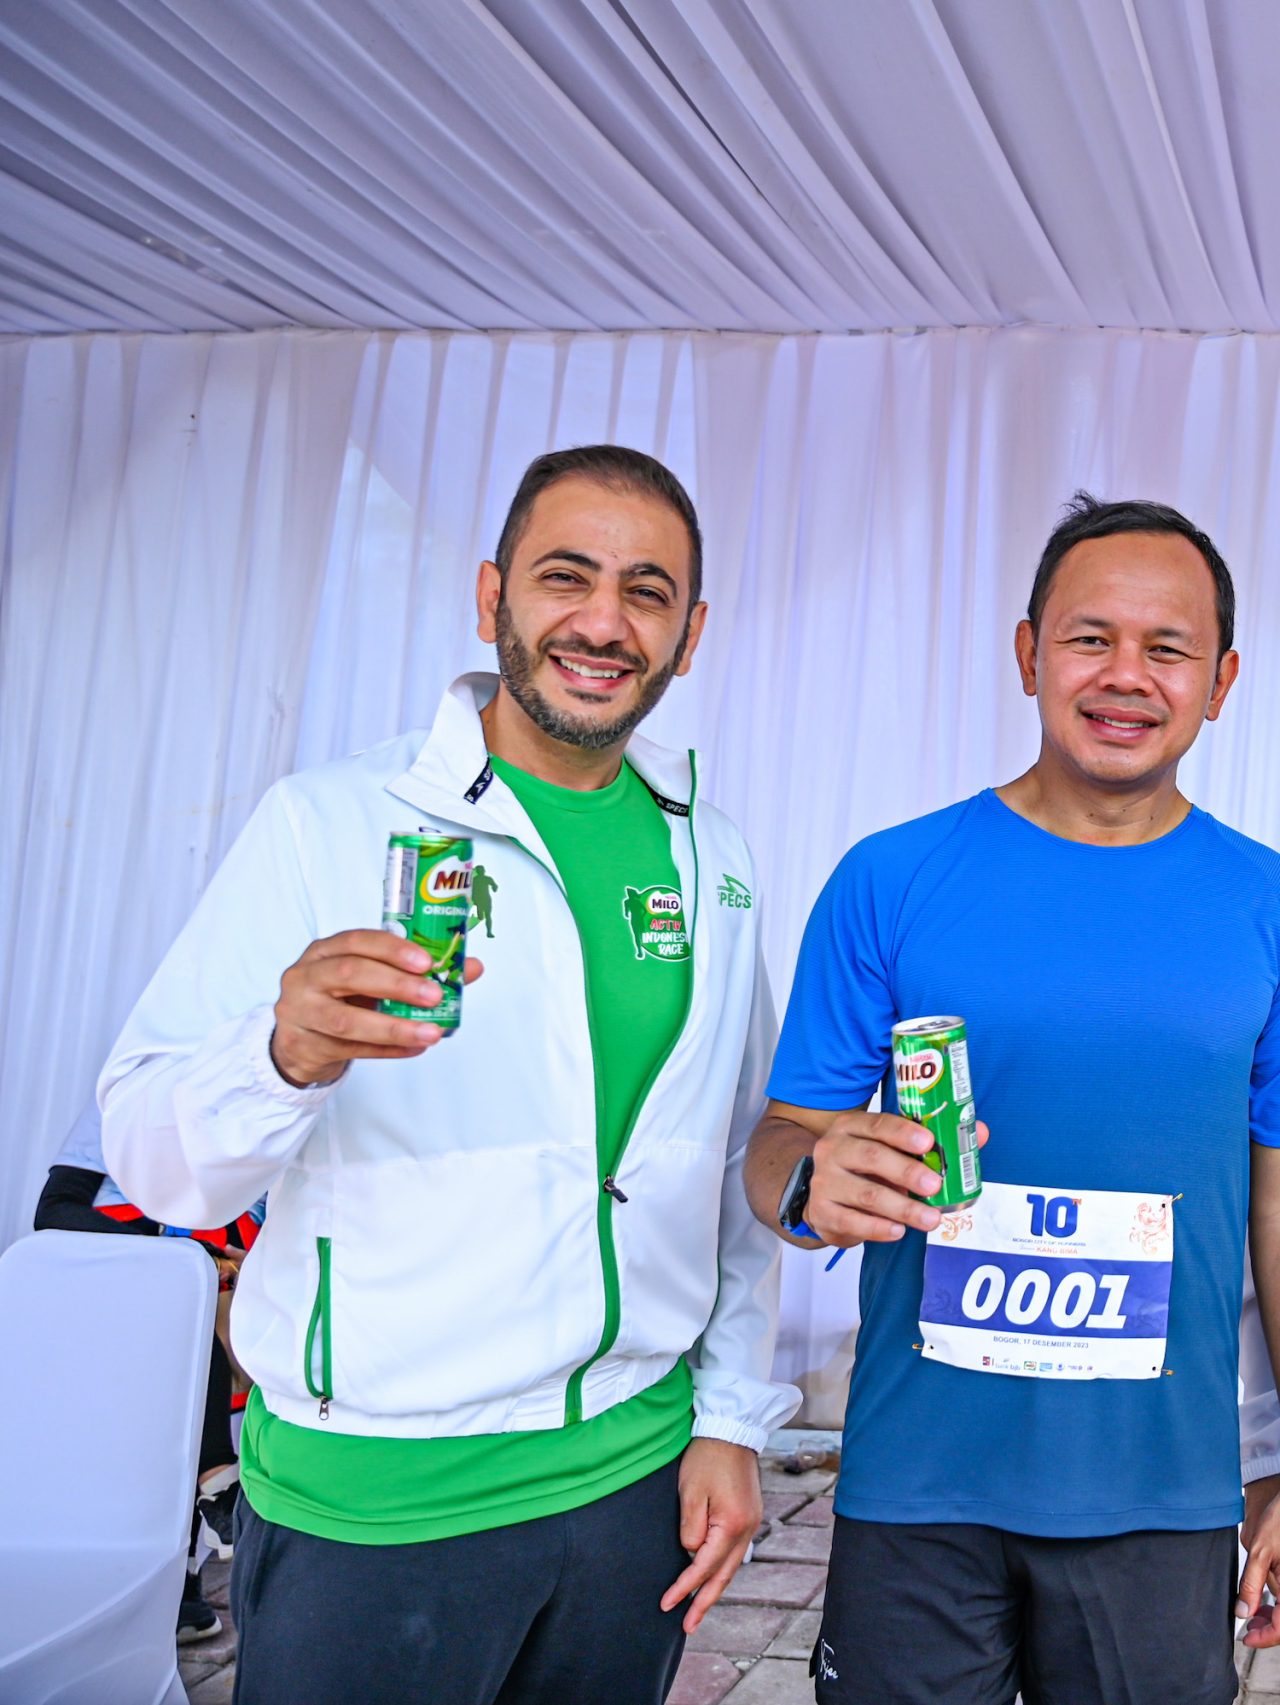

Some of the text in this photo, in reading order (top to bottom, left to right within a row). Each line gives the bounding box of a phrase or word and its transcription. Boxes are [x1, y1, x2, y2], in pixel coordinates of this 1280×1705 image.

[433, 870, 472, 890] MIL
[652, 898, 679, 909] MILO
[717, 891, 752, 909] PECS
[422, 904, 468, 916] ORIGINA
[641, 932, 686, 943] INDONES
[657, 943, 684, 956] RACE
[961, 1264, 1130, 1329] 0001
[1032, 1339, 1071, 1348] DESEMBER
